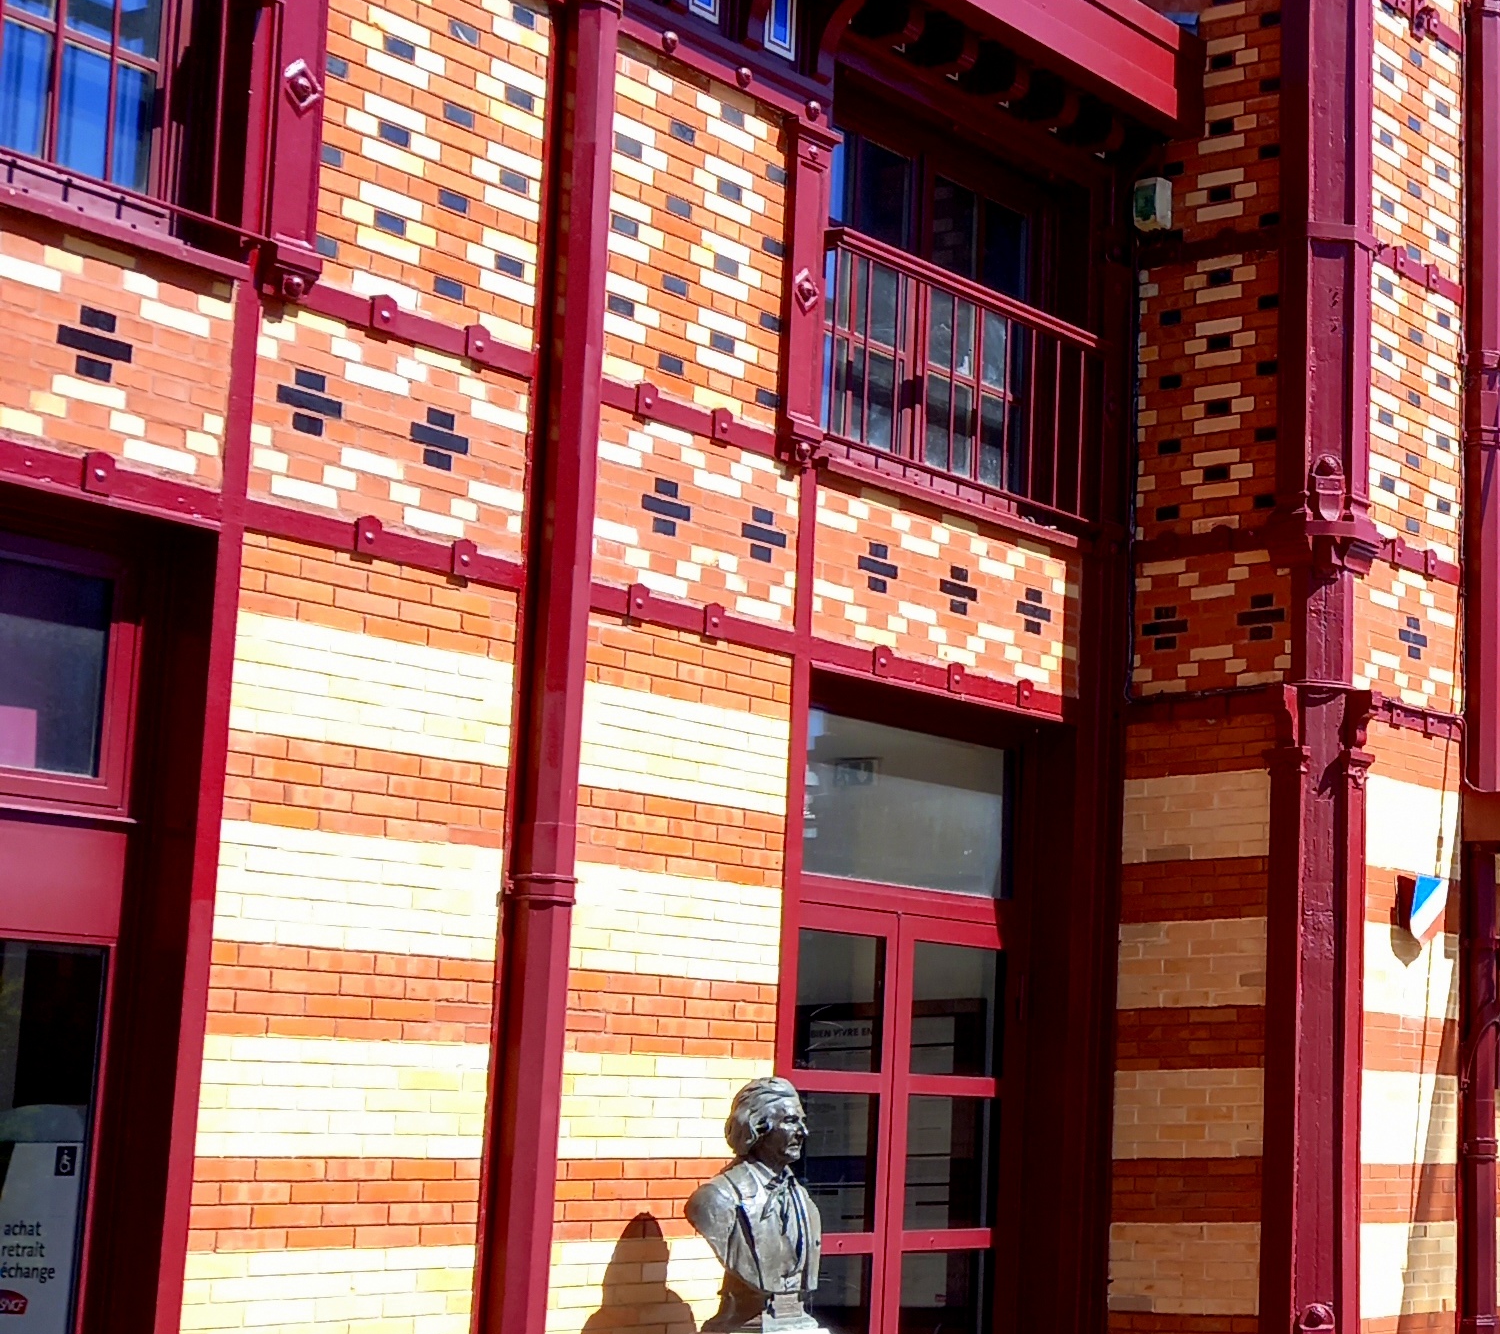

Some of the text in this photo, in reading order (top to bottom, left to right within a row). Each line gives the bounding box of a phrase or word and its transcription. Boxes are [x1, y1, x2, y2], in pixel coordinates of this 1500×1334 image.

[811, 1030, 831, 1038] BIEN
[4, 1220, 42, 1236] achat
[2, 1241, 45, 1258] retrait
[0, 1262, 56, 1283] échange
